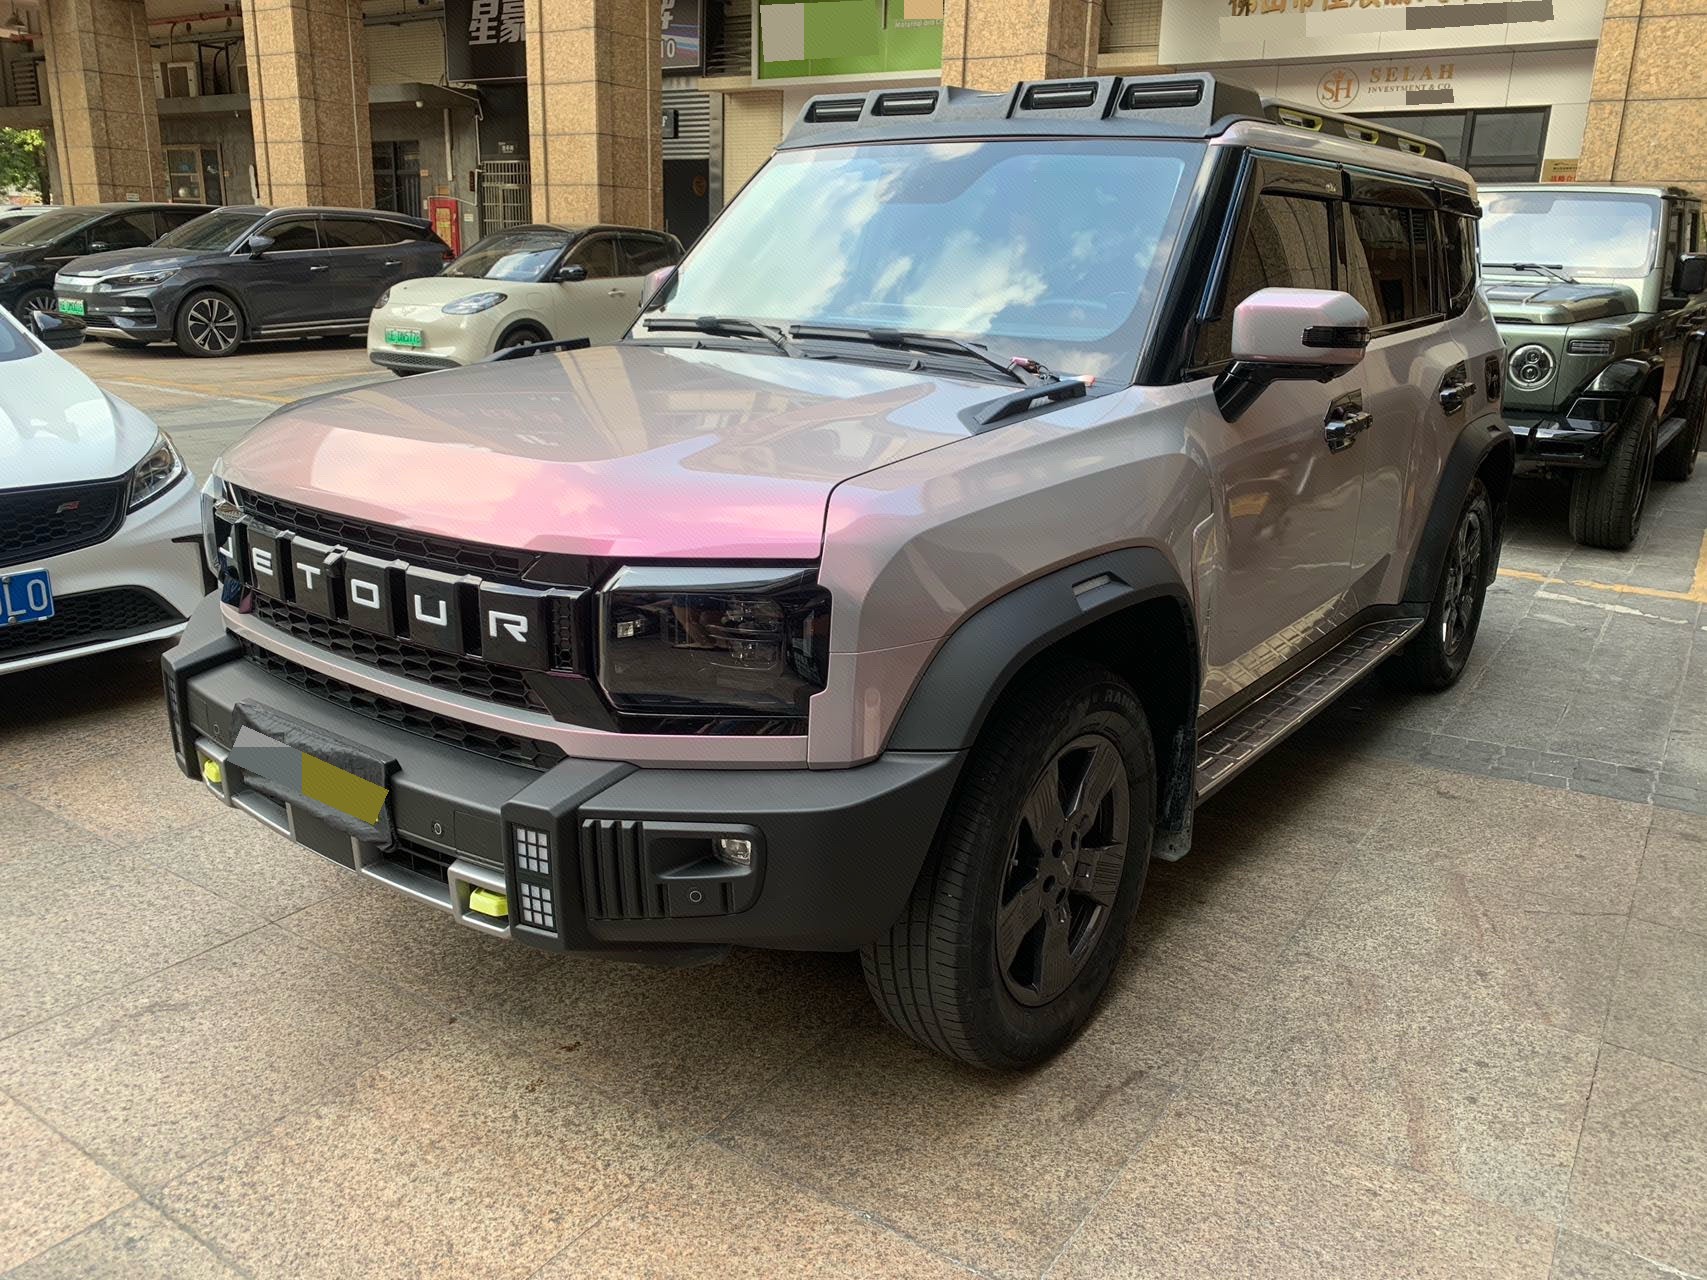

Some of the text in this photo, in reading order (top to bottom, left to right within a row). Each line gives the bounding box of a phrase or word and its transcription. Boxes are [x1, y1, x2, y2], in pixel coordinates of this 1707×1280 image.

[1369, 63, 1456, 84] SELAH
[1367, 84, 1427, 94] INVESTMENT
[218, 536, 529, 643] JETOUR
